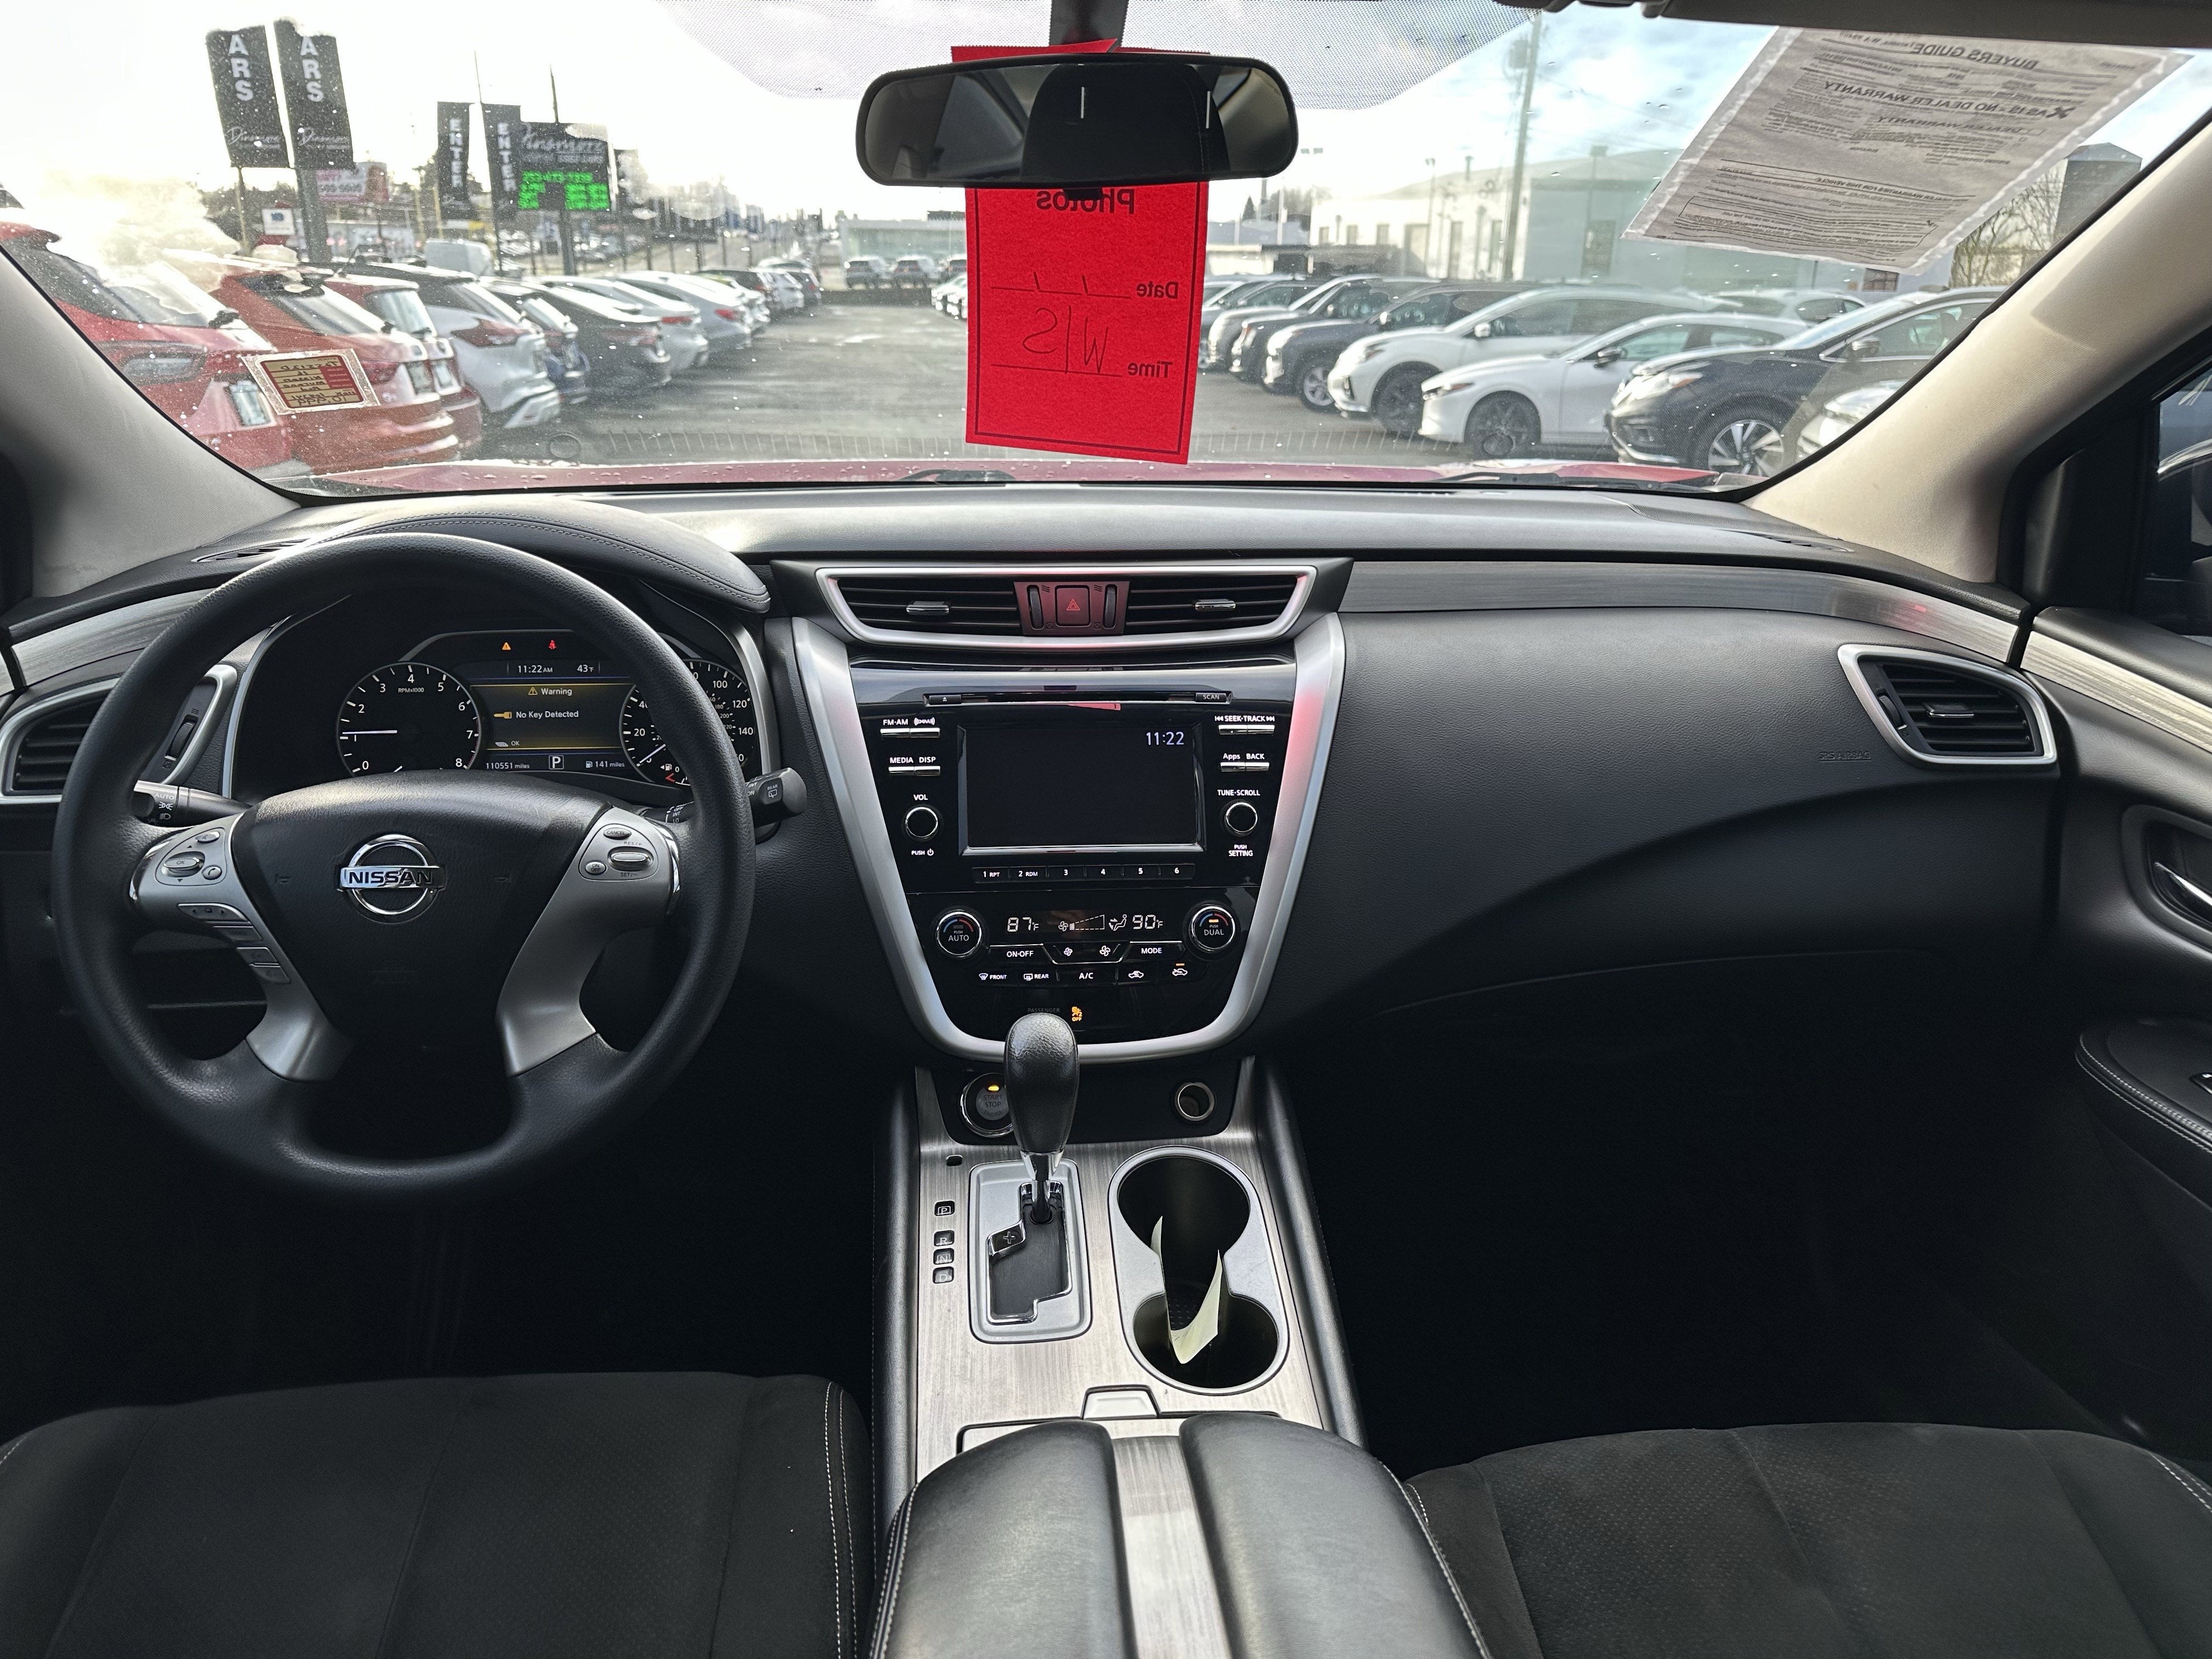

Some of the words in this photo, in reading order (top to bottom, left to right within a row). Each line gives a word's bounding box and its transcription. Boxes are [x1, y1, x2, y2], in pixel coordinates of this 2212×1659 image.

[448, 118, 463, 188] ENTER
[497, 122, 517, 191] ENTER
[407, 674, 414, 684] 4
[380, 683, 386, 693] 3
[438, 682, 444, 692] 5
[713, 680, 728, 689] 100
[541, 687, 573, 696] Warning
[358, 704, 364, 713] 2
[458, 702, 465, 711] 6
[732, 700, 747, 708] 120
[529, 711, 543, 719] Key
[466, 730, 473, 739] 7
[634, 728, 646, 736] 20
[738, 727, 754, 735] 140
[1146, 731, 1184, 746] 11:22
[362, 760, 369, 770] 0
[455, 758, 462, 768] 8
[552, 756, 561, 768] P
[348, 869, 433, 885] NISSAN
[939, 1274, 948, 1282] D
